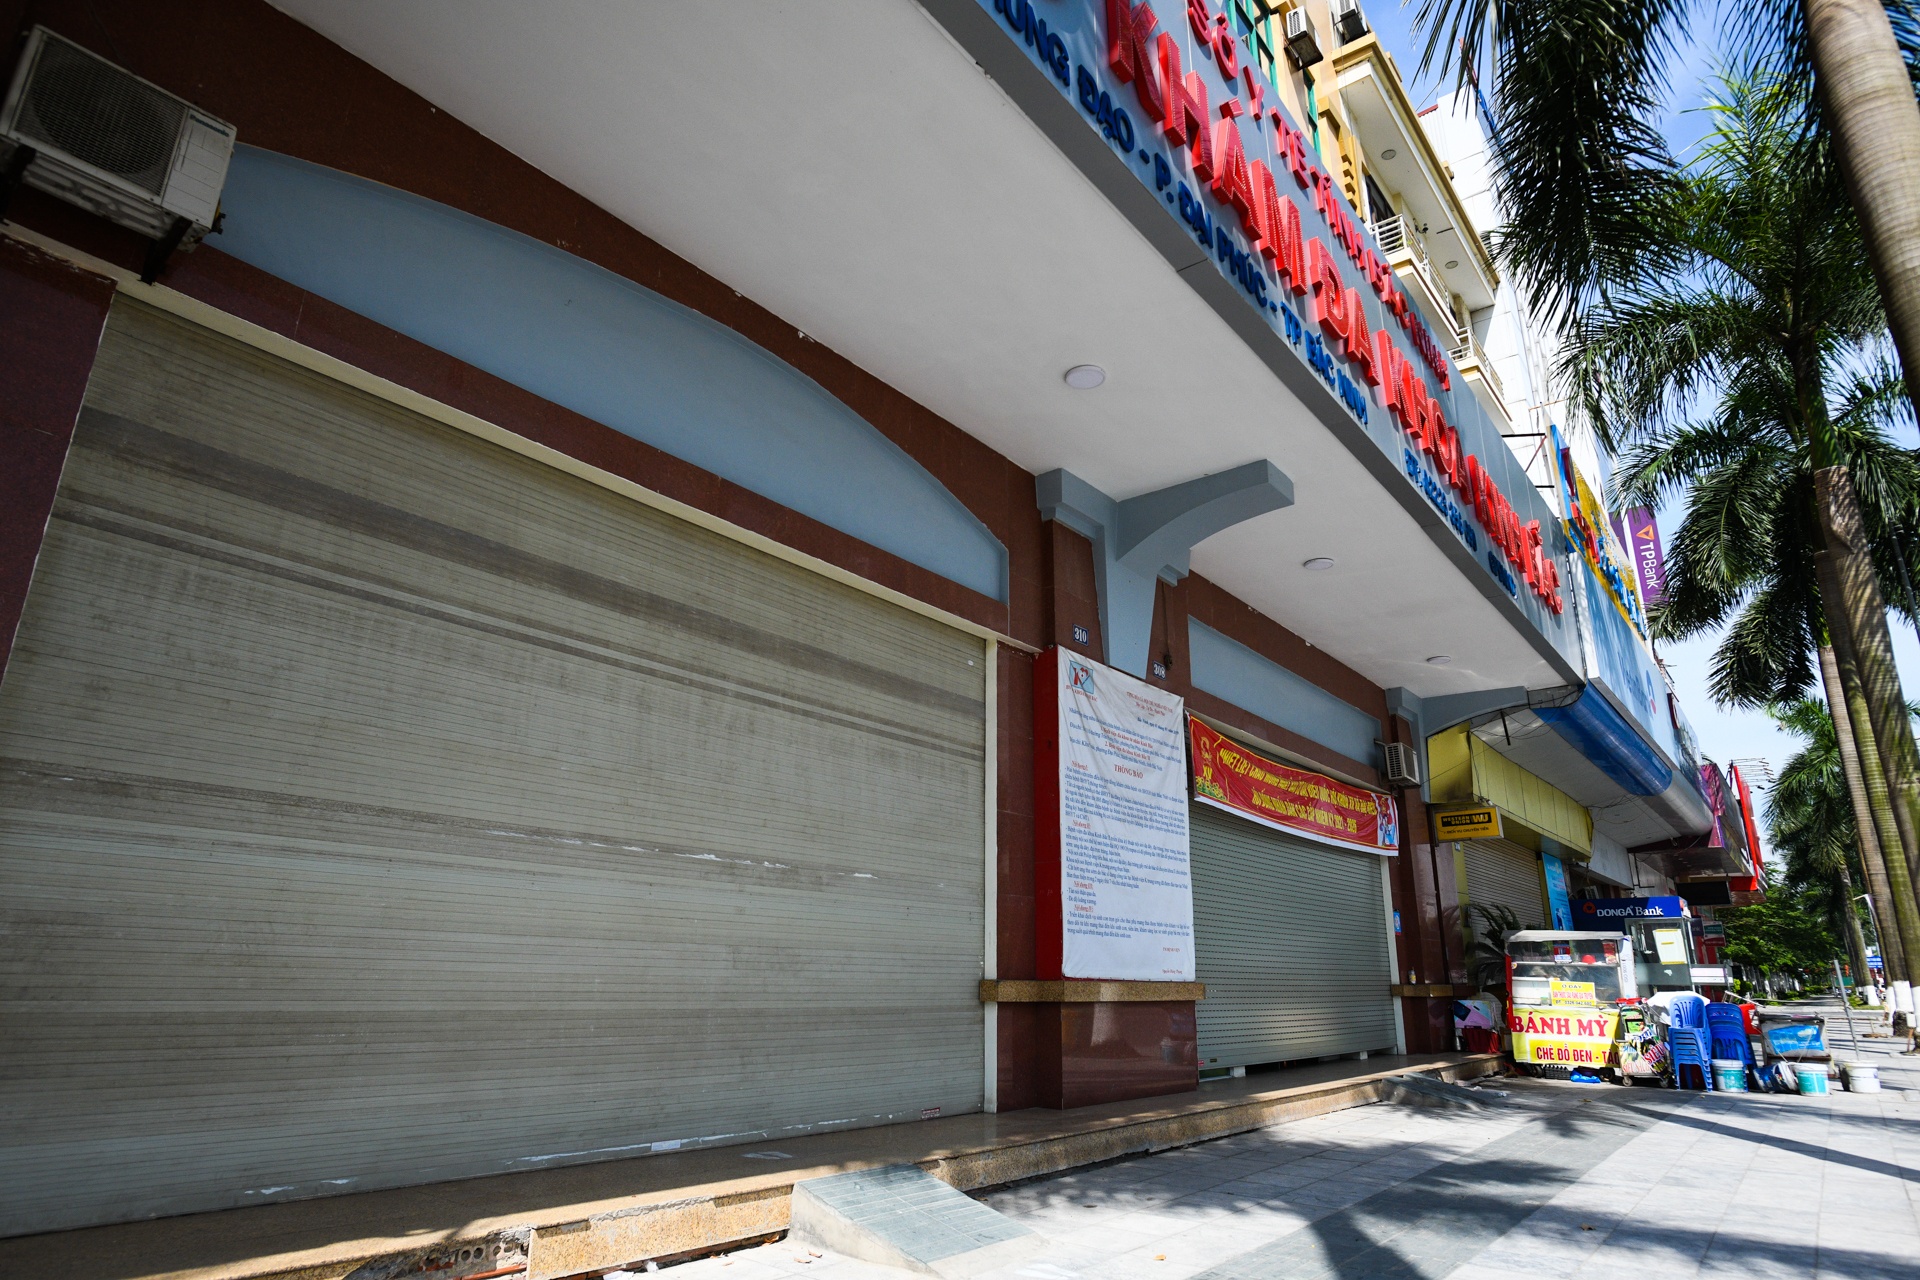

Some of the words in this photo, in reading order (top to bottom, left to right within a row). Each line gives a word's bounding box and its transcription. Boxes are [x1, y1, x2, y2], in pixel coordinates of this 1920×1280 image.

[190, 113, 230, 138] Panasonic
[1243, 65, 1265, 120] Y
[1269, 106, 1310, 189] TẾ
[1310, 164, 1366, 270] TỈNH
[1367, 248, 1410, 329] BẮC
[1078, 64, 1135, 153] ĐẠO
[1154, 153, 1175, 204] P.
[1178, 181, 1214, 249] ĐẠI
[1217, 225, 1268, 308] PHÚC
[1305, 329, 1336, 387] BẮC
[1336, 368, 1368, 425] NINH
[1106, 0, 1307, 296] KHÁM
[1309, 236, 1380, 387] ĐA
[1376, 328, 1473, 505] KHOA
[1467, 454, 1527, 573] KINH
[1520, 519, 1563, 615] BẮC
[1640, 541, 1661, 590] TPBank
[1075, 627, 1086, 643] 310
[1154, 664, 1166, 678] 308
[1114, 762, 1132, 776] THÔNG
[1132, 767, 1143, 779] BÁO
[1635, 906, 1664, 916] Bank
[1512, 1011, 1571, 1034] BÁNH
[1576, 1015, 1608, 1037] MỲ
[1536, 1044, 1555, 1060] CHÈ
[1573, 1049, 1592, 1062] ĐEN
